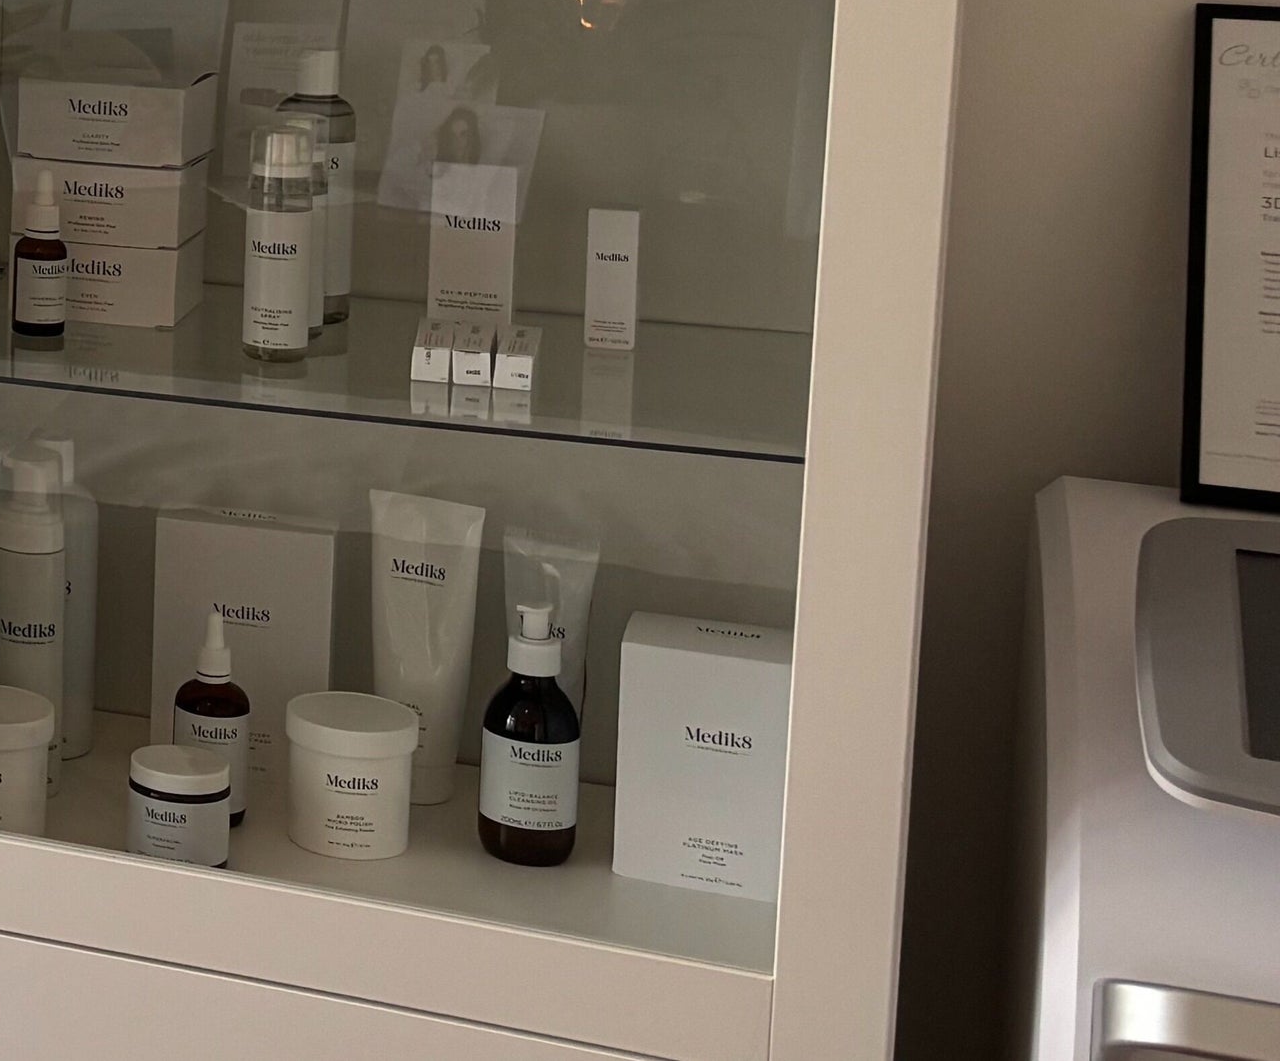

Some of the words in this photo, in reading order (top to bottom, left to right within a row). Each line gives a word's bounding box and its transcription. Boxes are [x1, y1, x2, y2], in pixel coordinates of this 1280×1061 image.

[68, 98, 128, 117] Medik8
[63, 179, 125, 199] Medik8
[444, 214, 501, 232] Medik8
[251, 239, 298, 256] Medik8
[595, 251, 630, 263] Medik8
[390, 556, 447, 582] Medik8
[213, 602, 271, 623] Medik8
[0, 618, 56, 639] Medik8
[190, 723, 238, 740] Medik8
[684, 725, 753, 750] Medik8
[510, 744, 562, 763] Medik8
[326, 773, 379, 790] Medik8
[144, 806, 187, 825] Medik8
